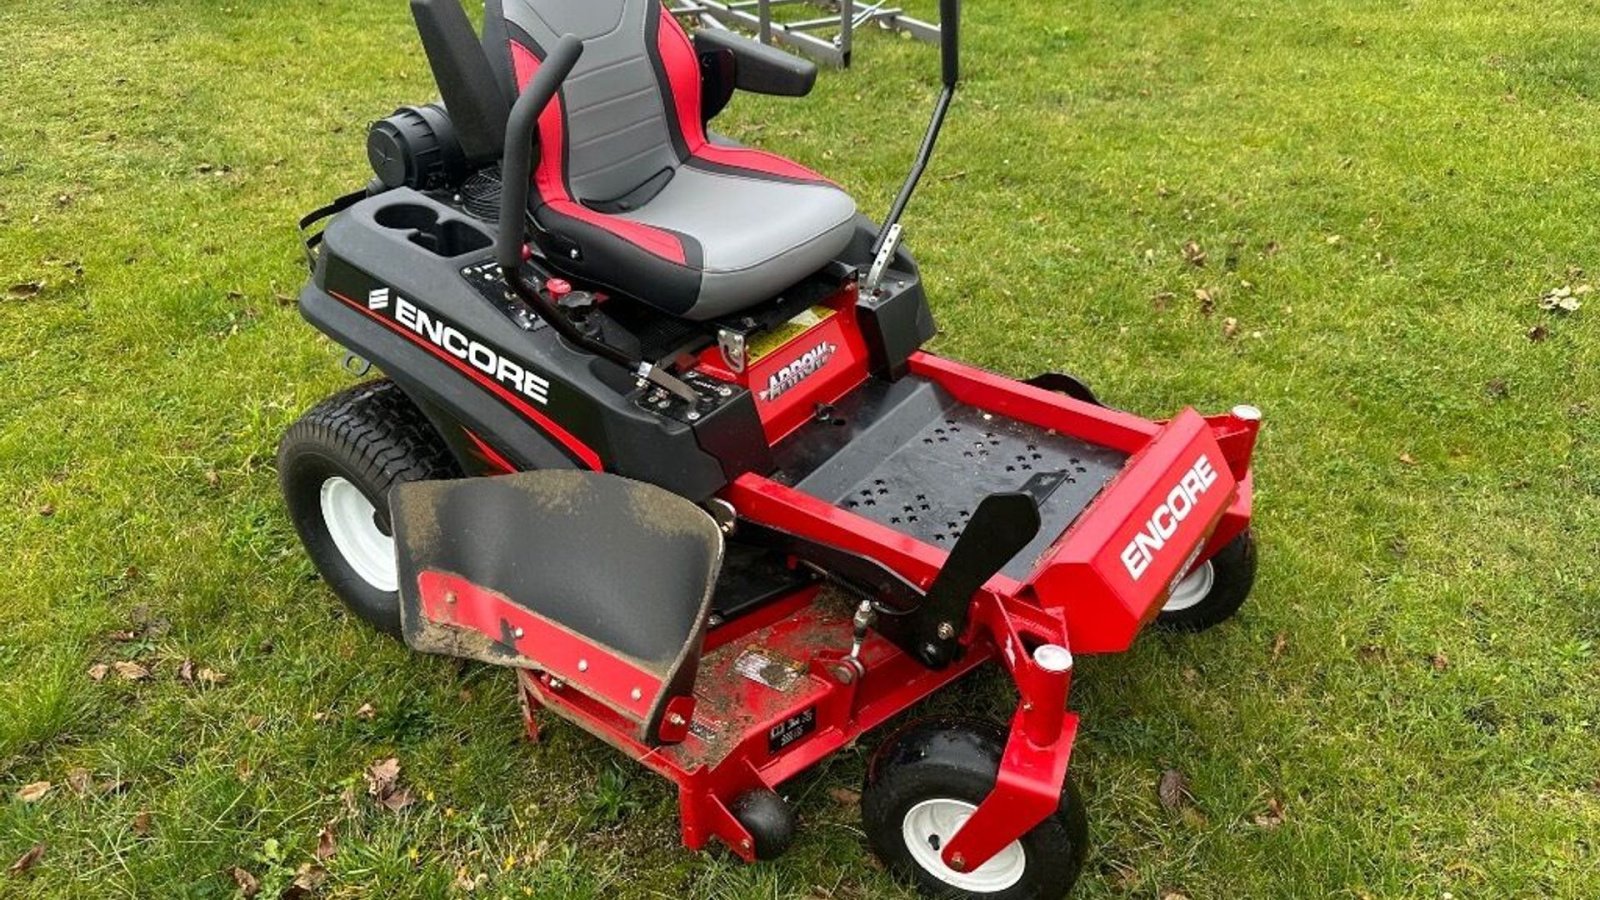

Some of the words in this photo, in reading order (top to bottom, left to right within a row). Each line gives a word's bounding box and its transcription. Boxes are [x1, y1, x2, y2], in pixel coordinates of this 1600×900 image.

[394, 296, 550, 405] ENCORE
[767, 341, 830, 400] ARROW
[1120, 453, 1219, 582] ENCORE
